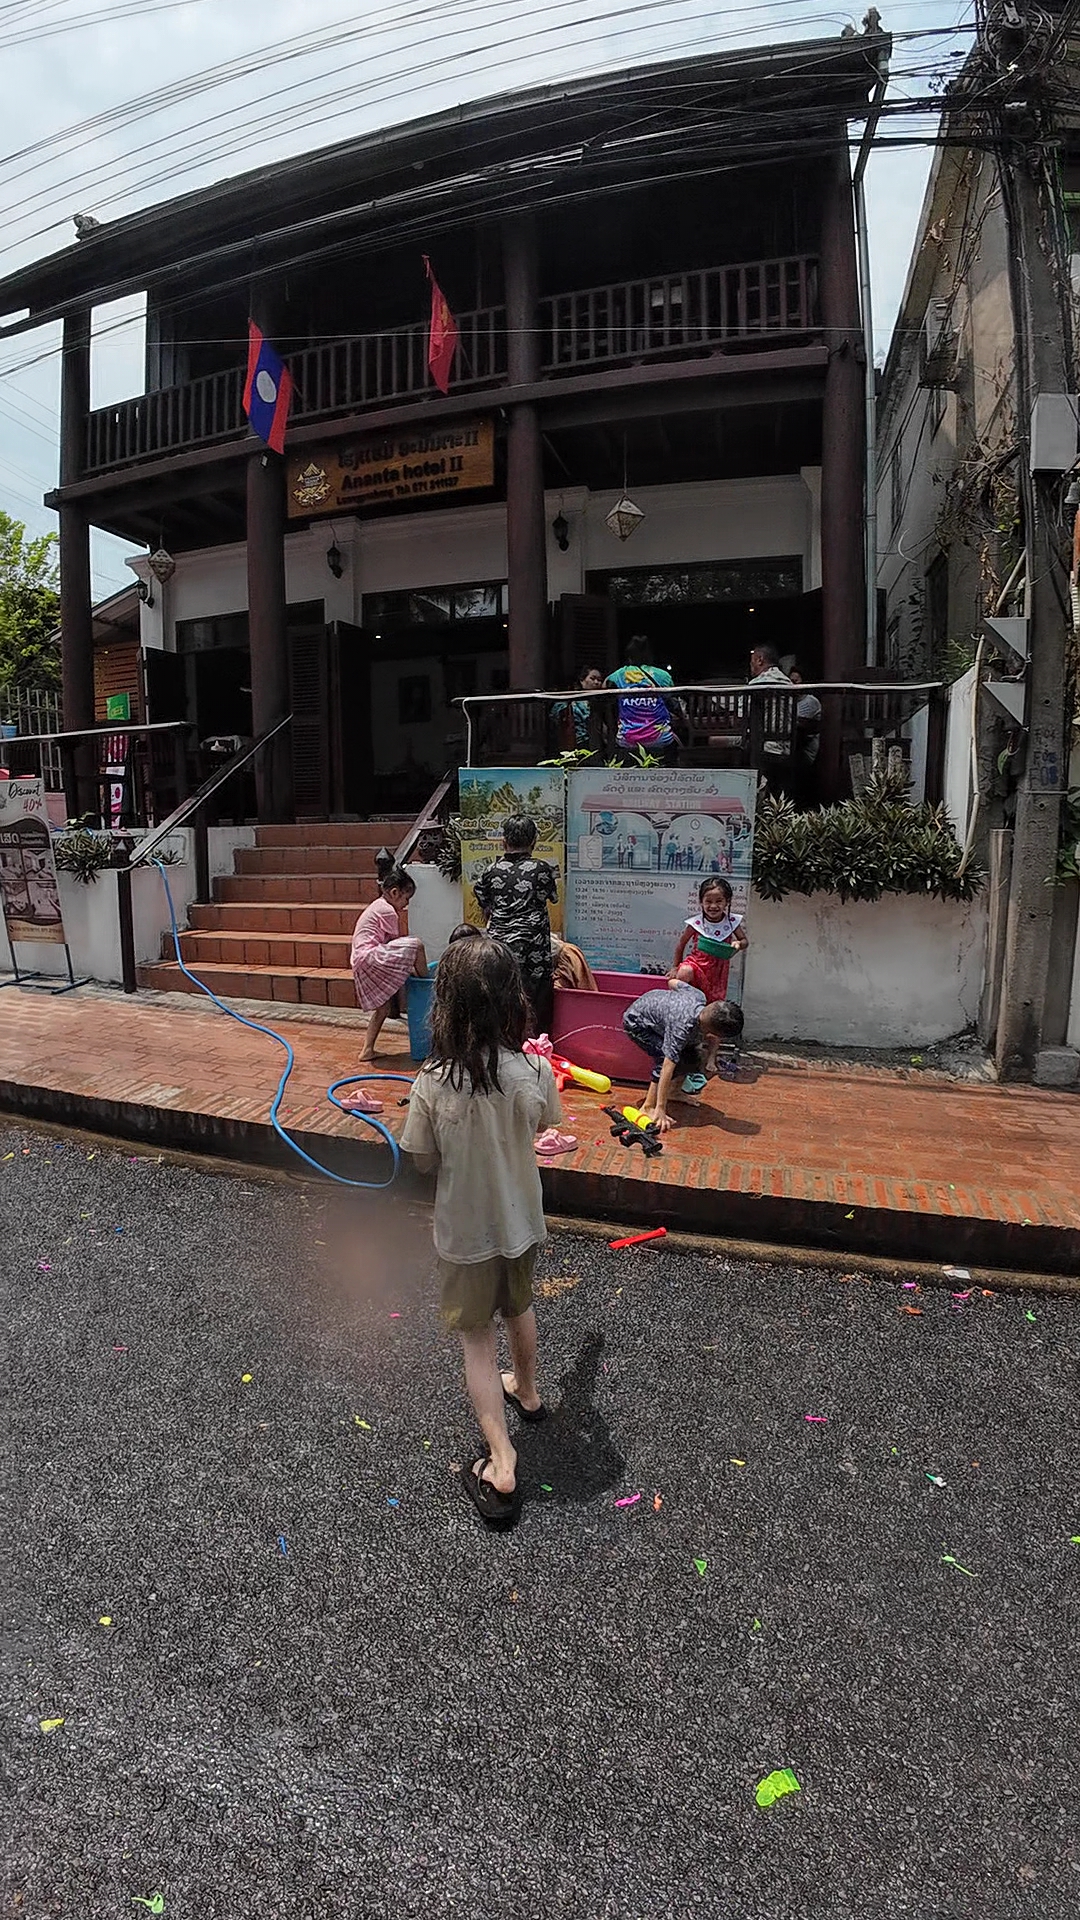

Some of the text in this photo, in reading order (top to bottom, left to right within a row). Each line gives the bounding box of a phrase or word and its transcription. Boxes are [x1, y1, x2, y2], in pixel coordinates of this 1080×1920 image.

[341, 468, 400, 491] Ananta
[403, 456, 446, 480] hotel
[449, 455, 464, 473] II
[23, 799, 42, 812] 40%
